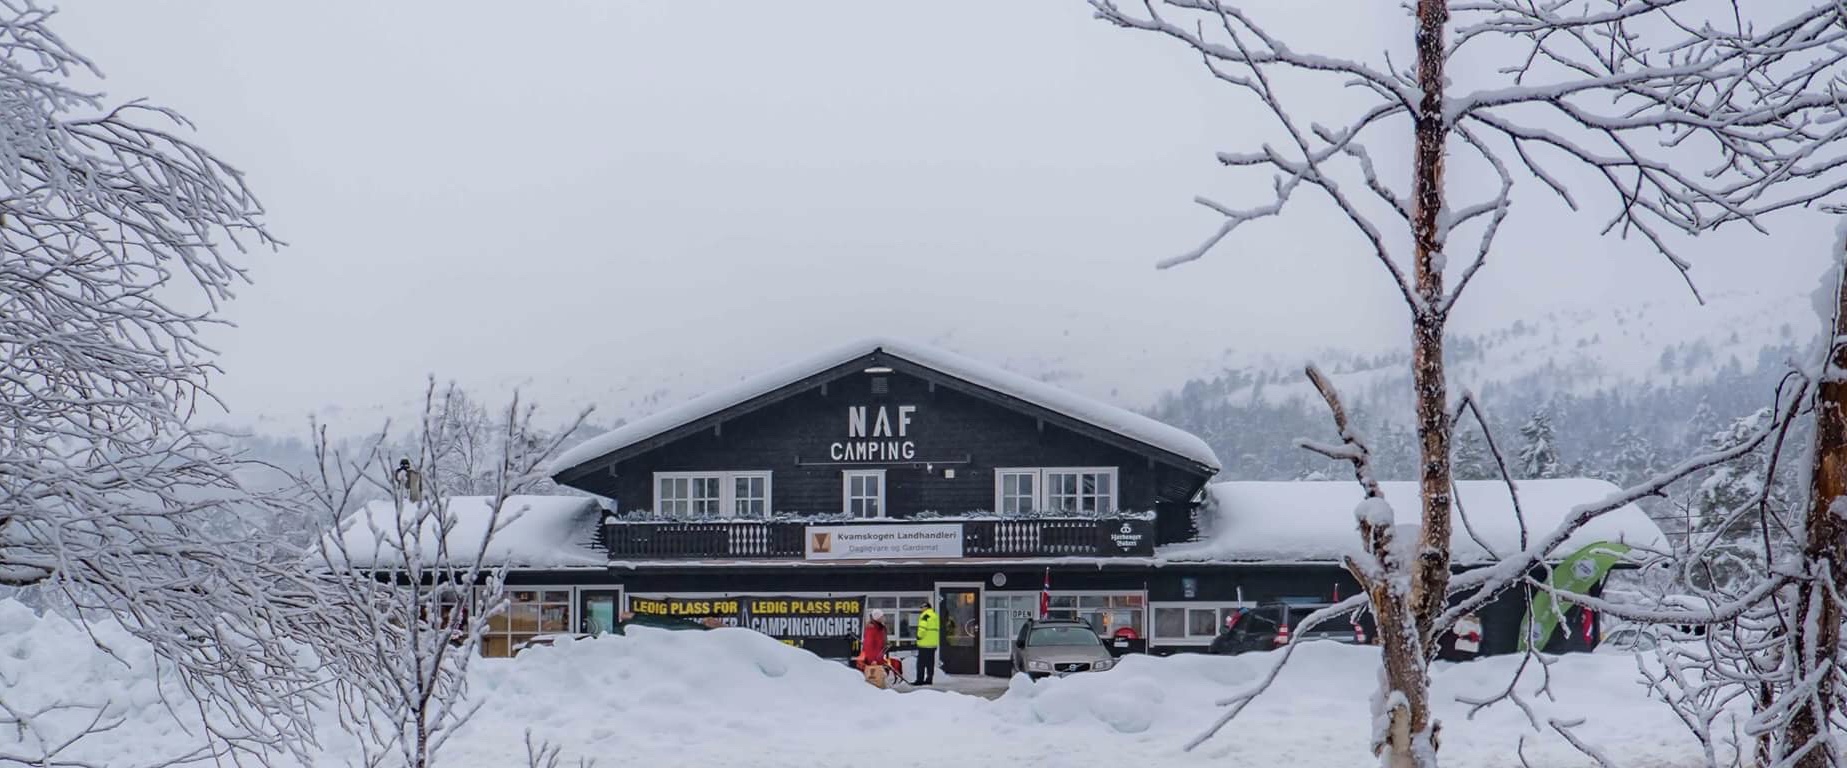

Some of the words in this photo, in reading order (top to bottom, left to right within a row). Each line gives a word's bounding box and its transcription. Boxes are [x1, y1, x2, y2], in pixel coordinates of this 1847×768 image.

[848, 405, 917, 438] NAF
[830, 441, 915, 461] CAMPING
[838, 532, 895, 542] Kvamskogen
[897, 530, 957, 540] Landhandleri
[633, 600, 668, 615] LEDIG
[670, 602, 710, 615] PLASS
[713, 601, 738, 614] FOR
[751, 601, 788, 614] LEDIG
[791, 601, 831, 614] PLASS
[835, 601, 860, 614] FOR
[1013, 610, 1032, 618] OPEN
[751, 616, 860, 636] CAMPINGVOGNER
